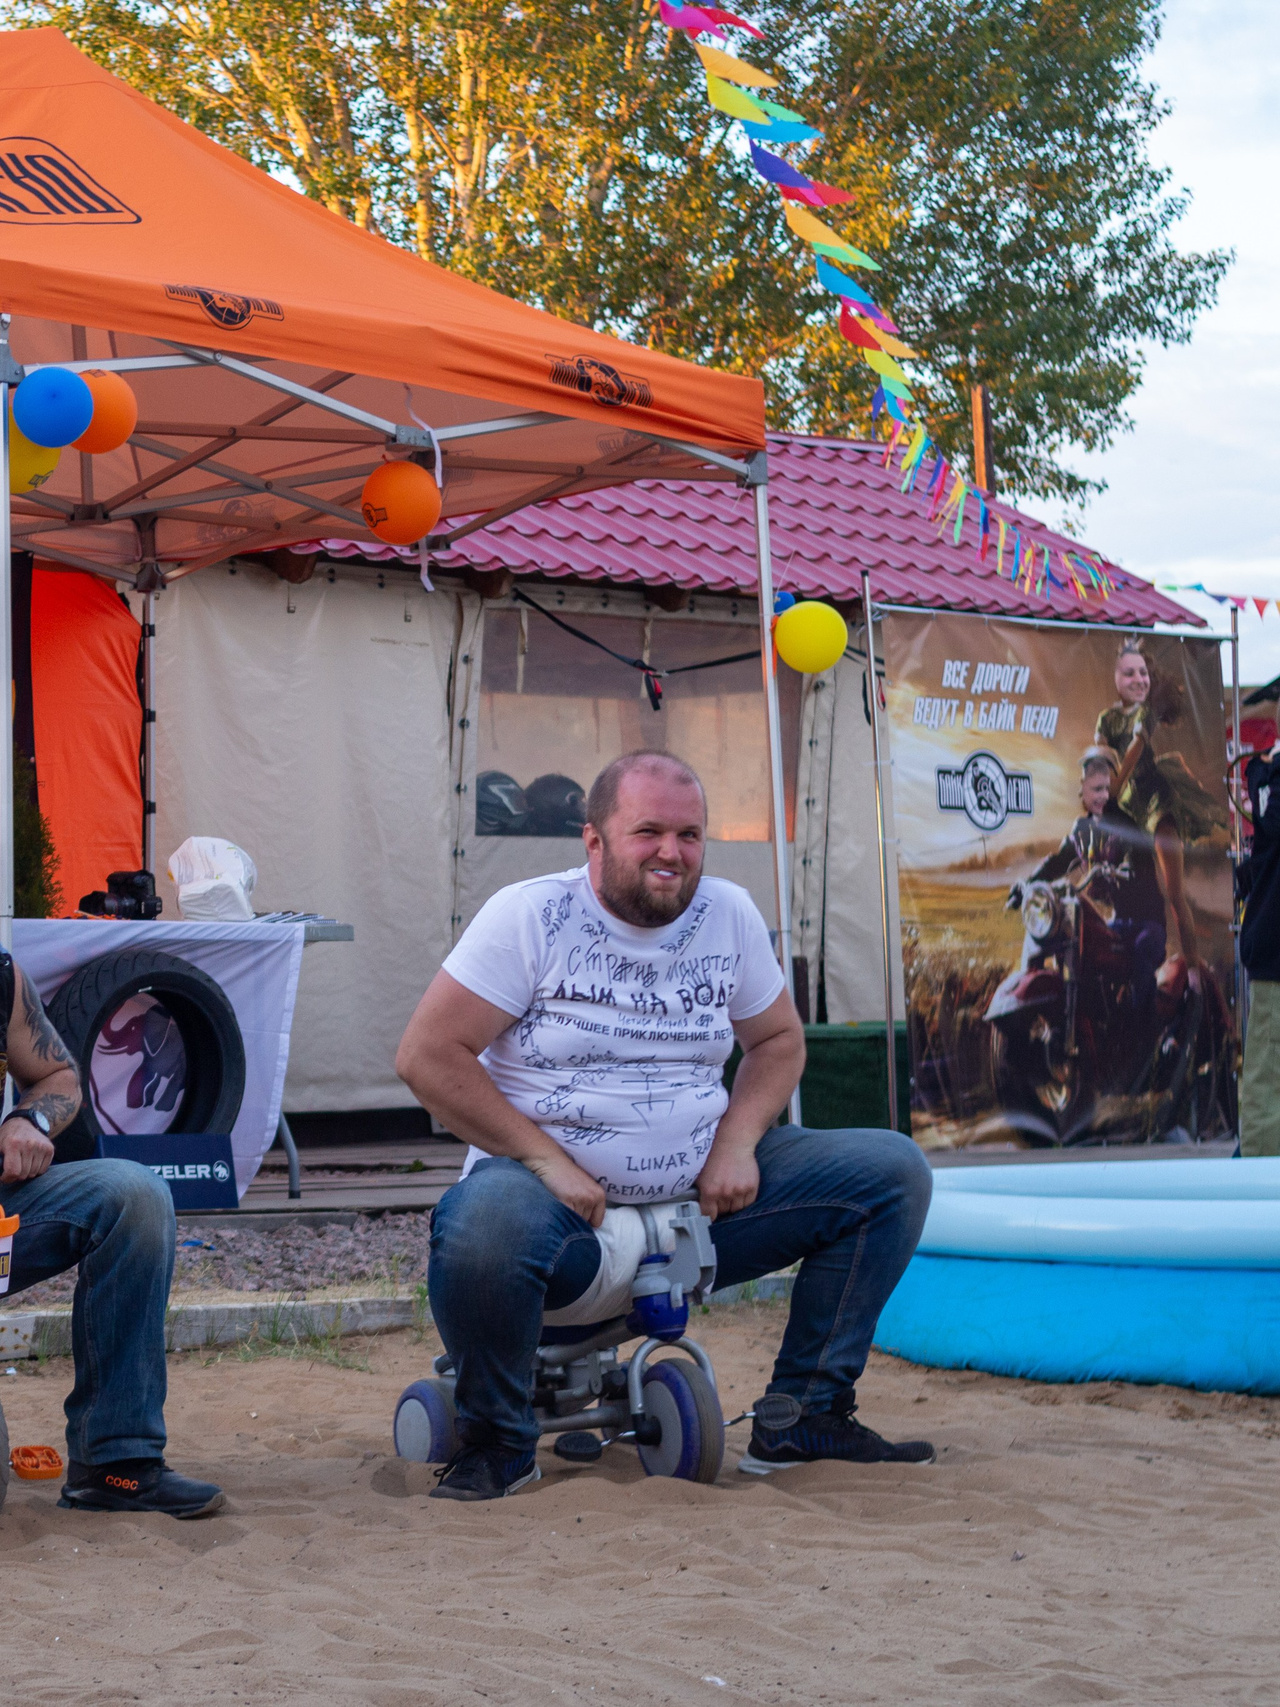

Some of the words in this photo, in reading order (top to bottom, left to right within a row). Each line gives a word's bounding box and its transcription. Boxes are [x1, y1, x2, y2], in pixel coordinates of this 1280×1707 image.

[942, 660, 970, 689] ВСЕ
[971, 662, 1030, 695] ДОРОГИ
[913, 696, 960, 730] ВЕДУТ
[963, 701, 974, 728] В
[978, 699, 1017, 731] БАЙК
[939, 770, 964, 807] БАЙК
[614, 1026, 710, 1042] ПРИКЛЮЧЕНИЕ
[149, 1164, 211, 1179] ZELER
[626, 1152, 690, 1172] LUNAR
